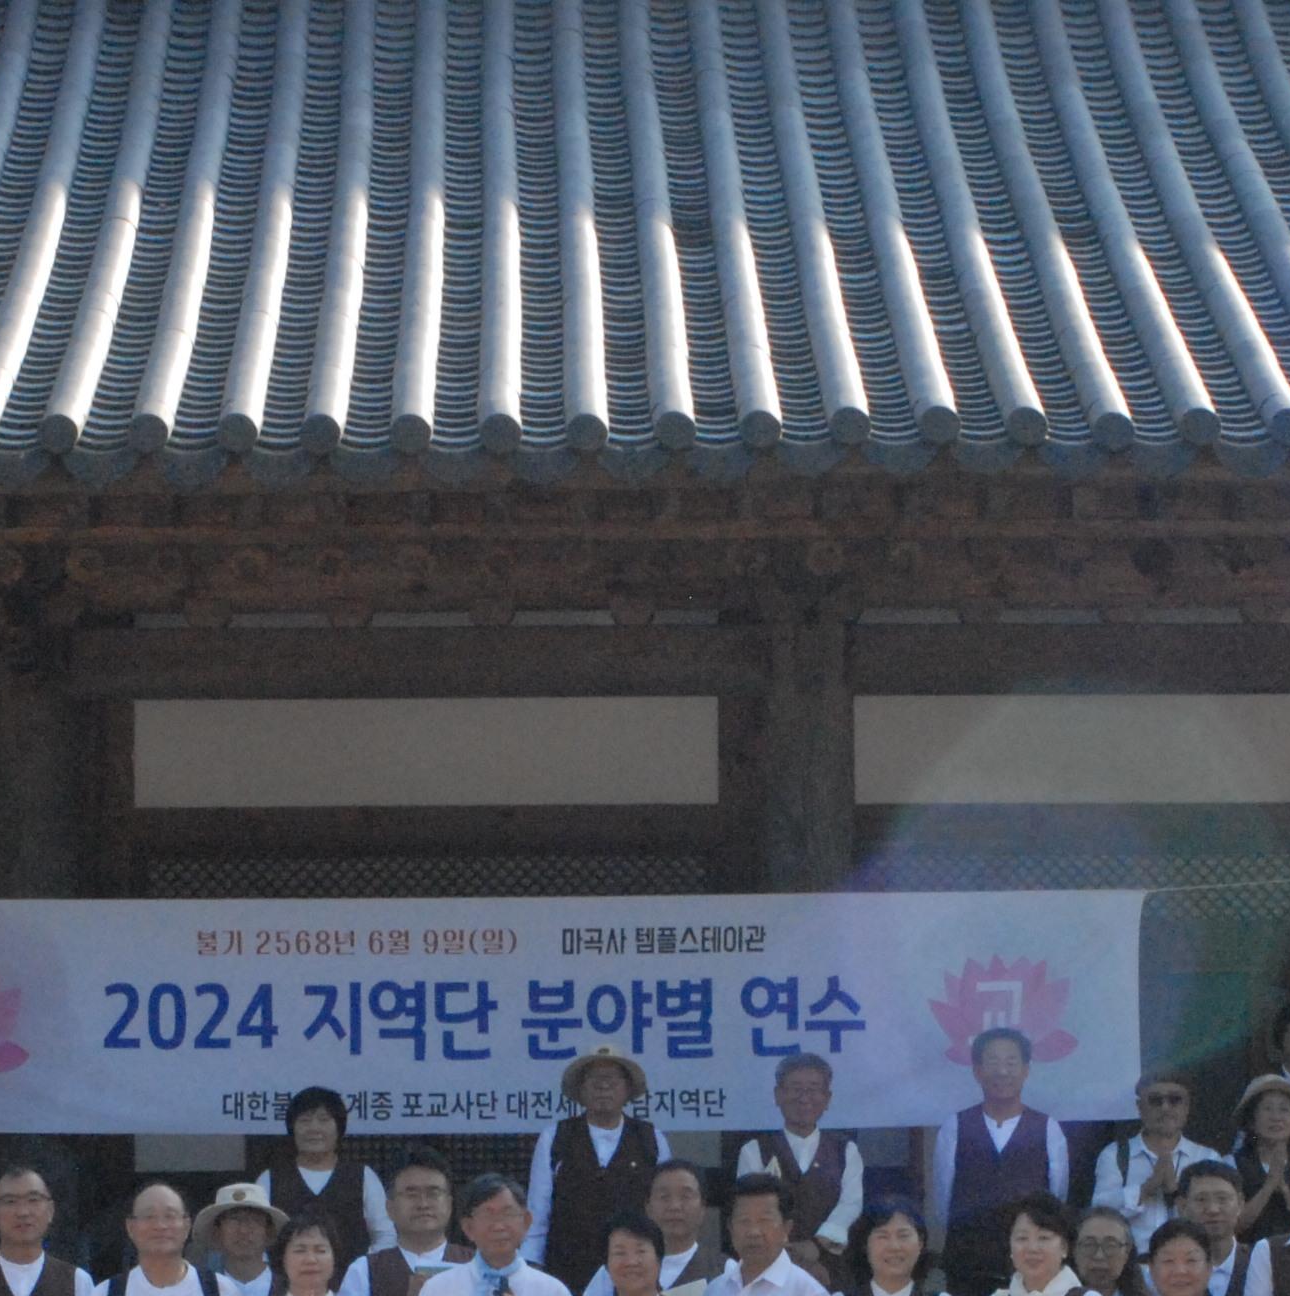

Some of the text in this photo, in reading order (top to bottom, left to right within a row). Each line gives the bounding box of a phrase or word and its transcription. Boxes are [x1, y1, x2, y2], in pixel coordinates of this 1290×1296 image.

[196, 925, 767, 956] 불기 2568년 6월 9일(일) 마곡사 템플스테이관
[103, 975, 866, 1061] 2024 지역단 분야별 연수
[222, 1091, 394, 1121] 대한불계종
[401, 1090, 498, 1120] 포교사단
